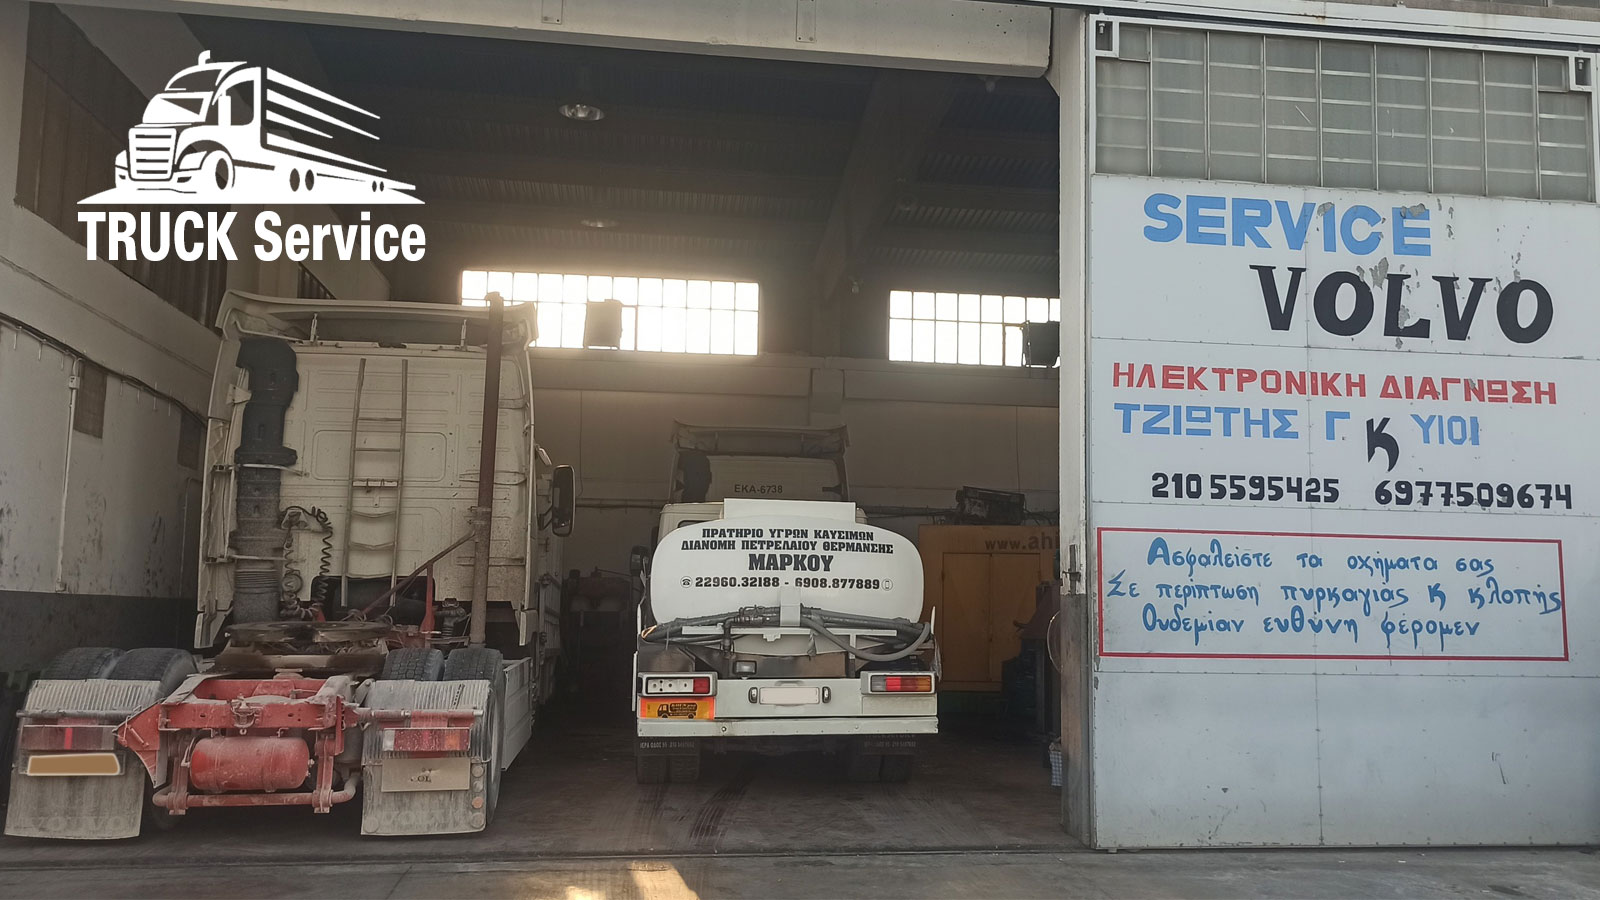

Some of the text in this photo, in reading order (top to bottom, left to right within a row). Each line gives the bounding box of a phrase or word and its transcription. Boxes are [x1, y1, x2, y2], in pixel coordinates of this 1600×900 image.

[1143, 193, 1431, 257] SERVICE
[1249, 264, 1554, 344] VOLVO
[1112, 362, 1557, 405] ΗΛΕΚΤΡΟΝΙΚΗ ΔΙΑΓΝΩΣΗ
[1113, 402, 1299, 440] ΤΖΙΩΤΗΣ
[1410, 413, 1480, 446] ΥΙΟΙ
[1151, 472, 1573, 510] 210 5595425 6977509674
[681, 540, 894, 554] ΔΙΑΝΟΜΗ ΠΕΤΡΕΛΑΙΟΥ ΘΕΡΜΑΝΣΗΣ
[702, 528, 874, 541] ΠΡΑΤΗΡΙΟ ΥΓΡΩΝ ΚΑΥΣΙΜΩΝ
[748, 553, 834, 572] ΜΑΡΚΟΥ
[1296, 552, 1323, 569] τα
[1347, 551, 1438, 583] οχήματα
[1455, 557, 1495, 578] σας
[695, 576, 780, 588] 22960.32188
[795, 577, 880, 590] 6908.877889
[1107, 569, 1140, 598] Σε
